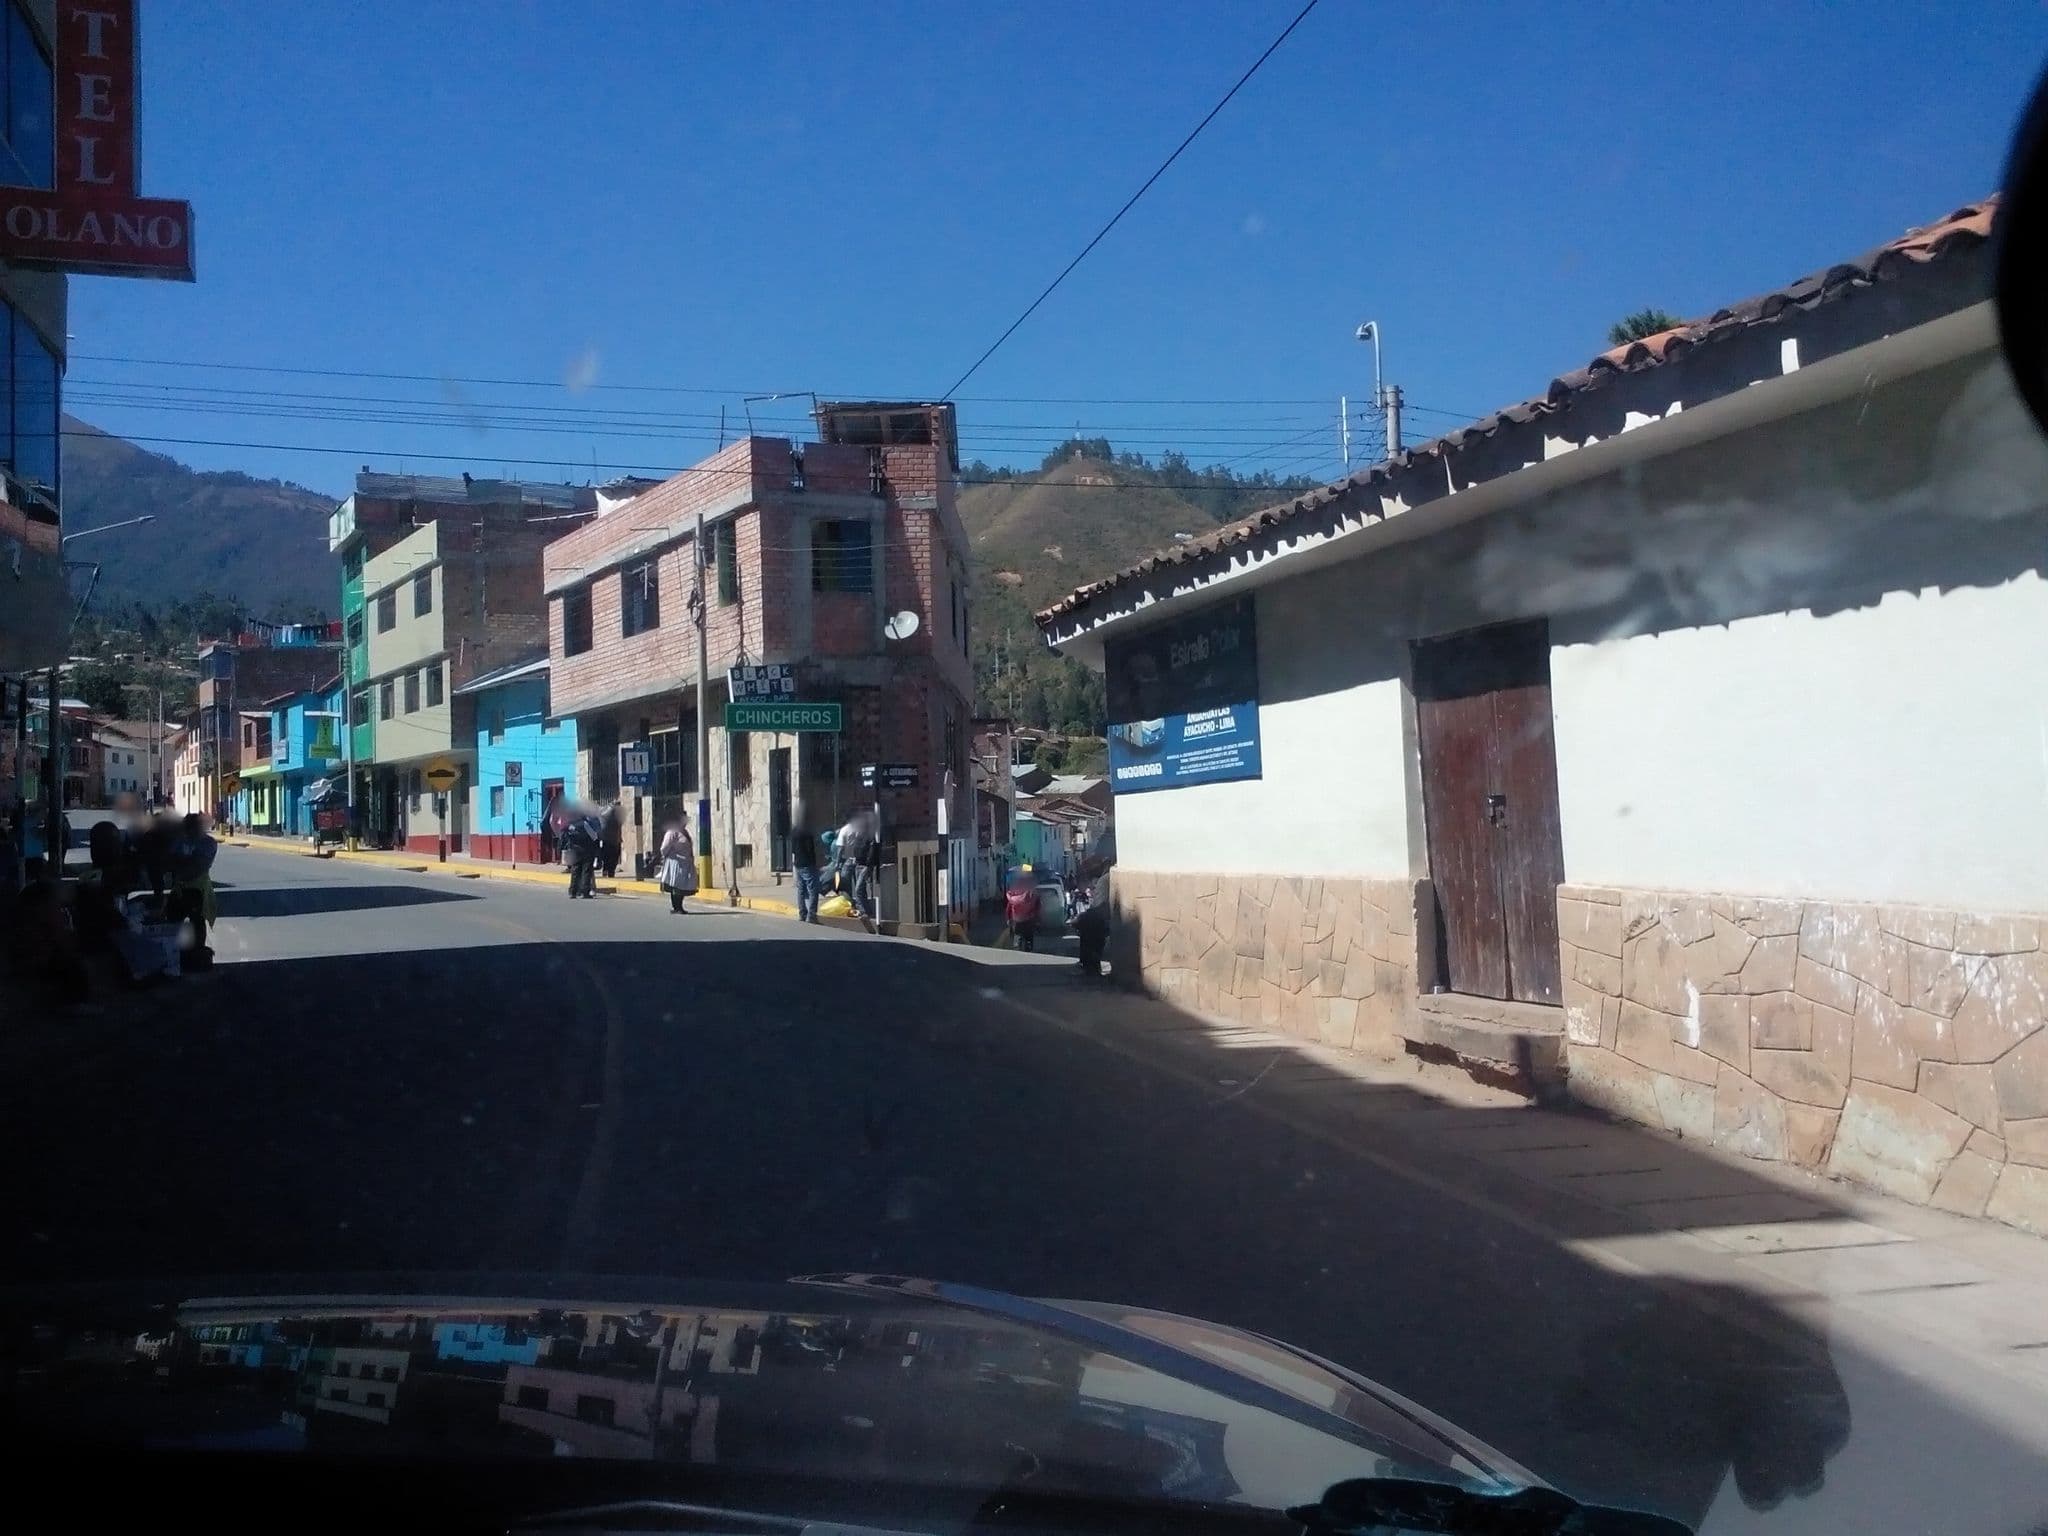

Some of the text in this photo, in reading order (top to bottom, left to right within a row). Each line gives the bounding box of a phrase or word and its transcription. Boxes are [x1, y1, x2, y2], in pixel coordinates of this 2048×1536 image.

[5, 204, 183, 250] OLANO
[1170, 633, 1209, 668] Estrella
[733, 665, 791, 680] BLACK
[734, 679, 792, 694] WHITE
[735, 710, 832, 724] CHINCHEROS
[1183, 721, 1215, 738] AYACUCHO
[1219, 716, 1236, 730] LIMA
